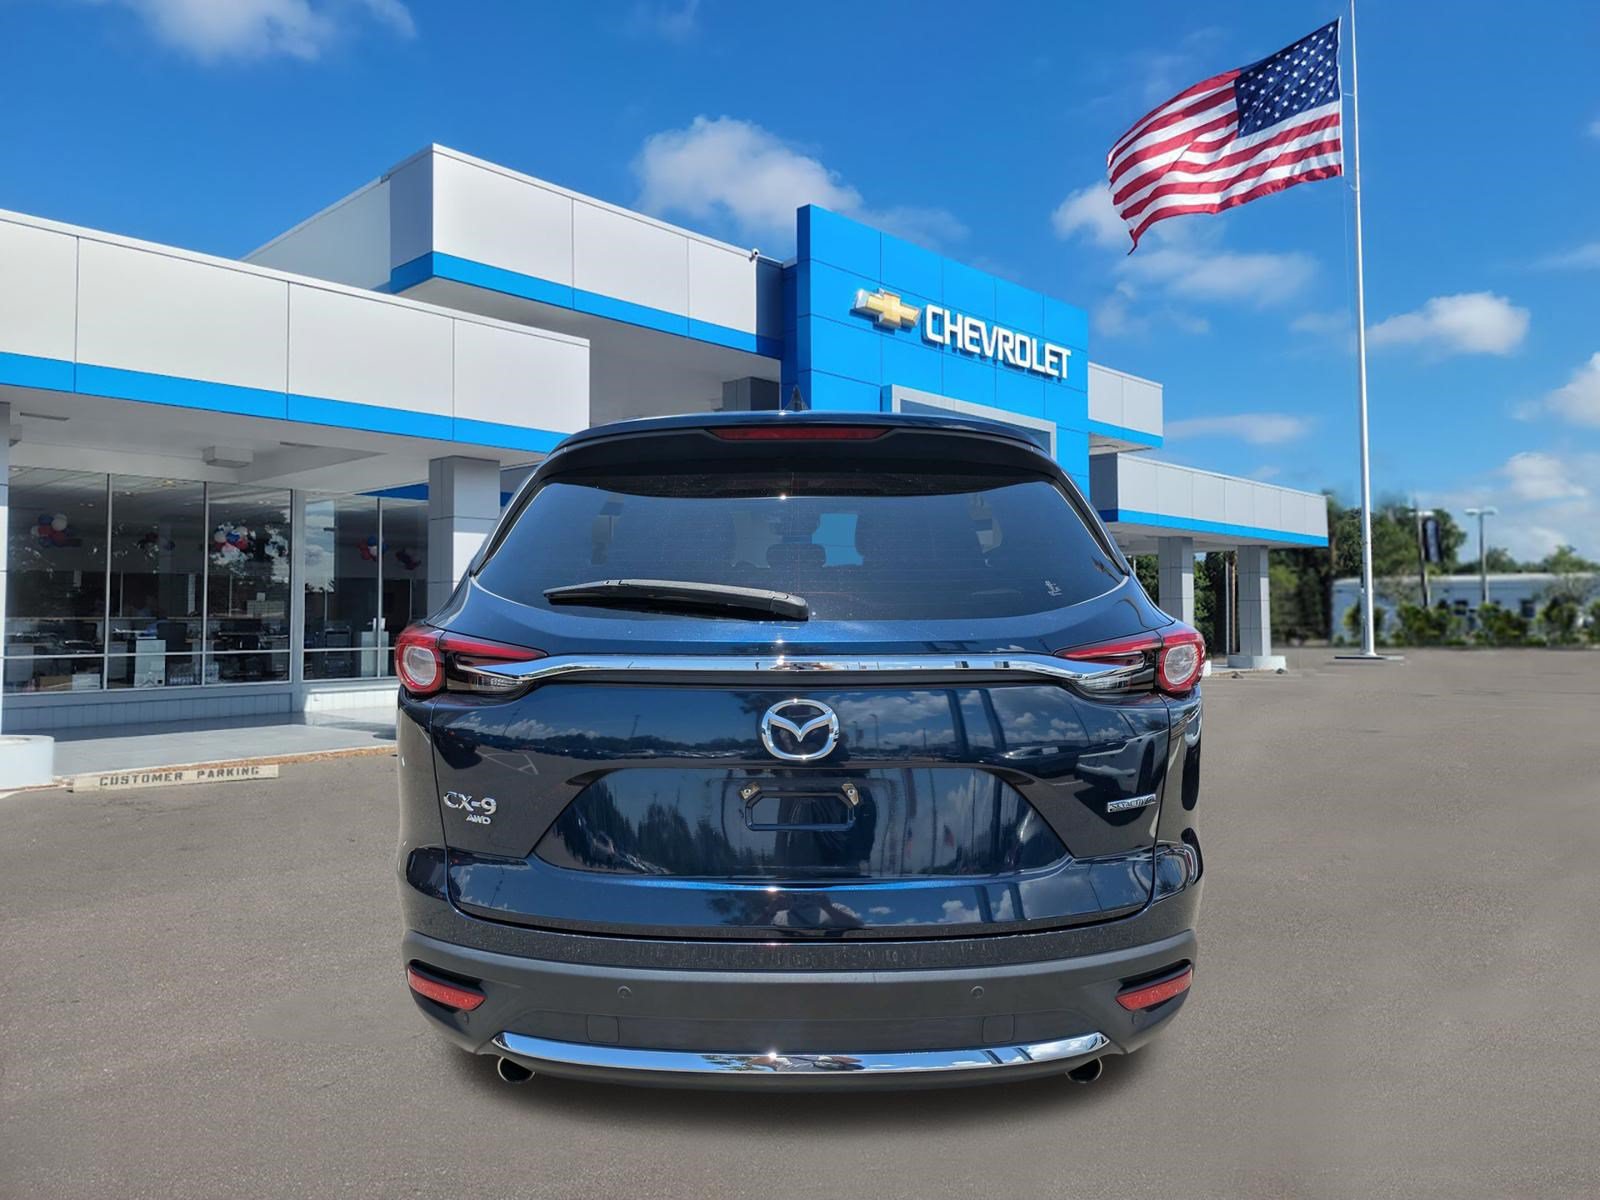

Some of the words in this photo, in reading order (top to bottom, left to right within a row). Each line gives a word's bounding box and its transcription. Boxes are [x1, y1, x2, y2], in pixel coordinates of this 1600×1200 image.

[924, 304, 1072, 379] CHEVROLET
[99, 772, 183, 786] CUSTOMER
[197, 767, 259, 779] PARKING
[443, 791, 497, 815] CX-9
[465, 814, 491, 825] AWD
